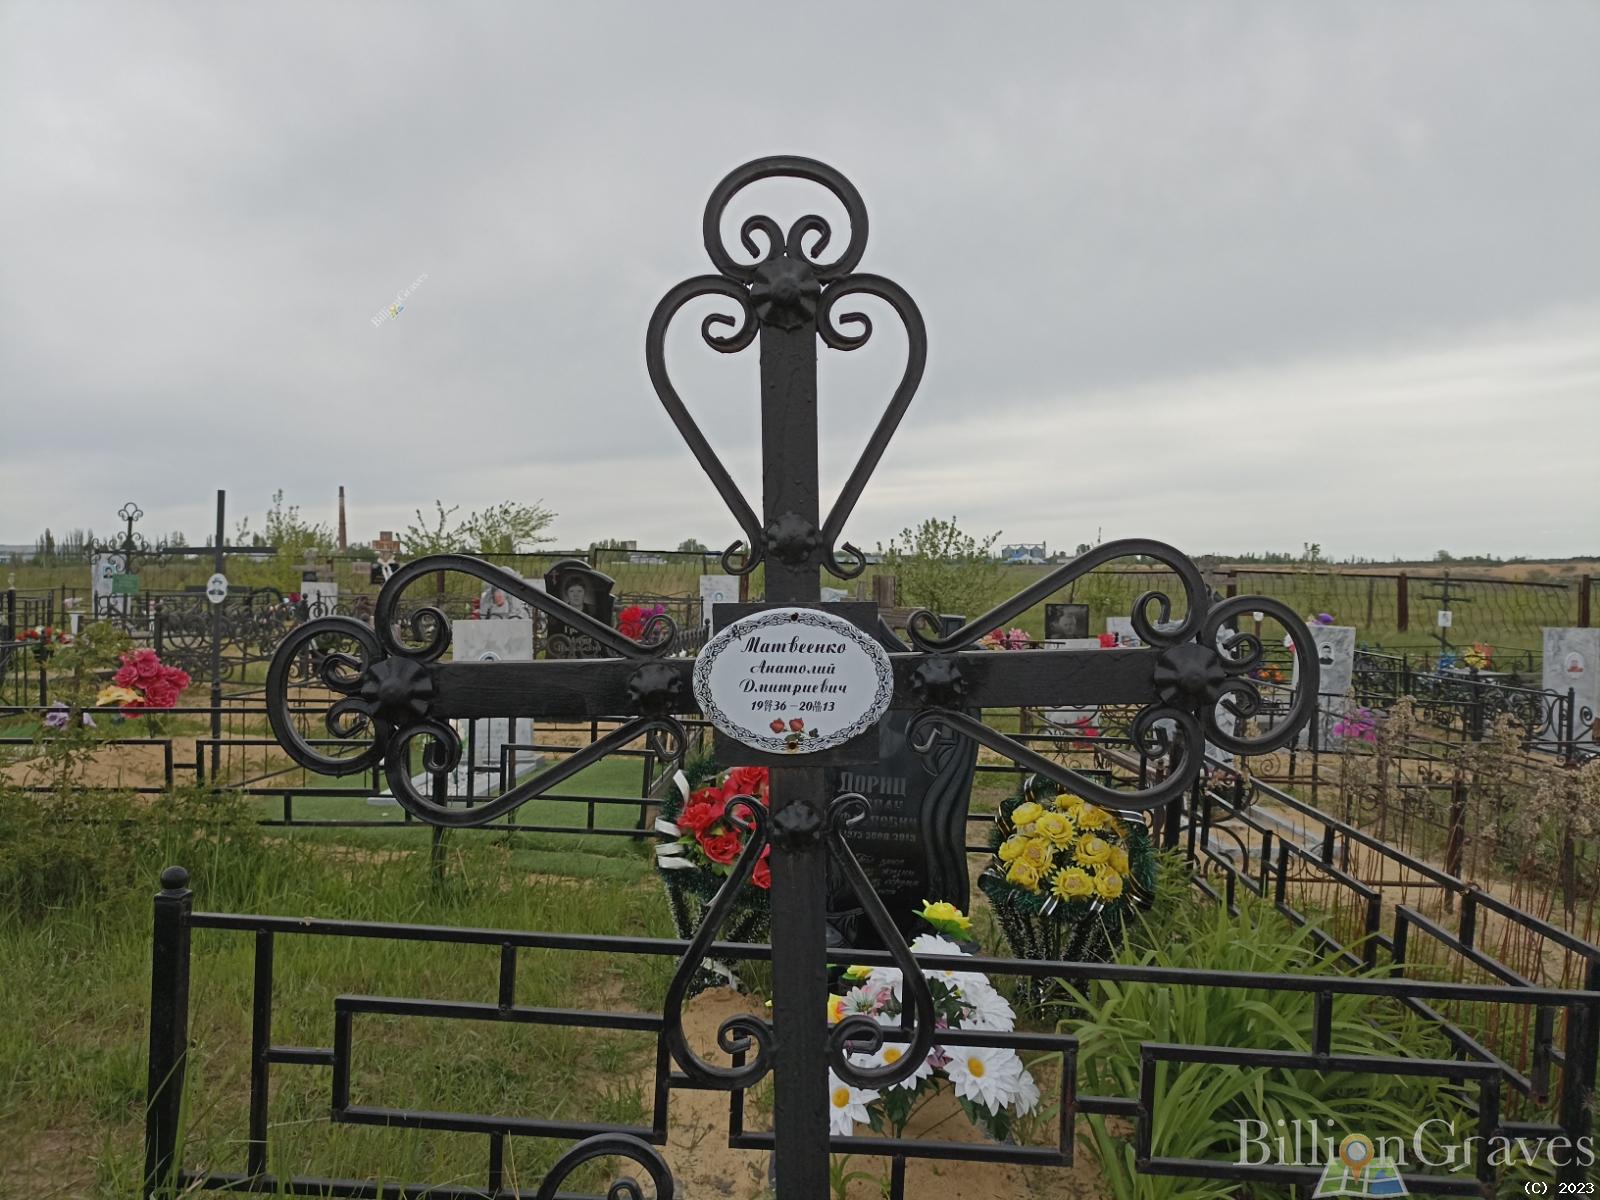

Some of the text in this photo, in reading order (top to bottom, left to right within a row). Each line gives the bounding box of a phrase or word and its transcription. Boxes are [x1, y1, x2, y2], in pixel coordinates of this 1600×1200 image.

[740, 636, 846, 653] Матвеенко
[750, 660, 835, 675] Анатолий
[739, 678, 847, 696] Дмитриевич
[838, 772, 906, 797] ДОРИЦ
